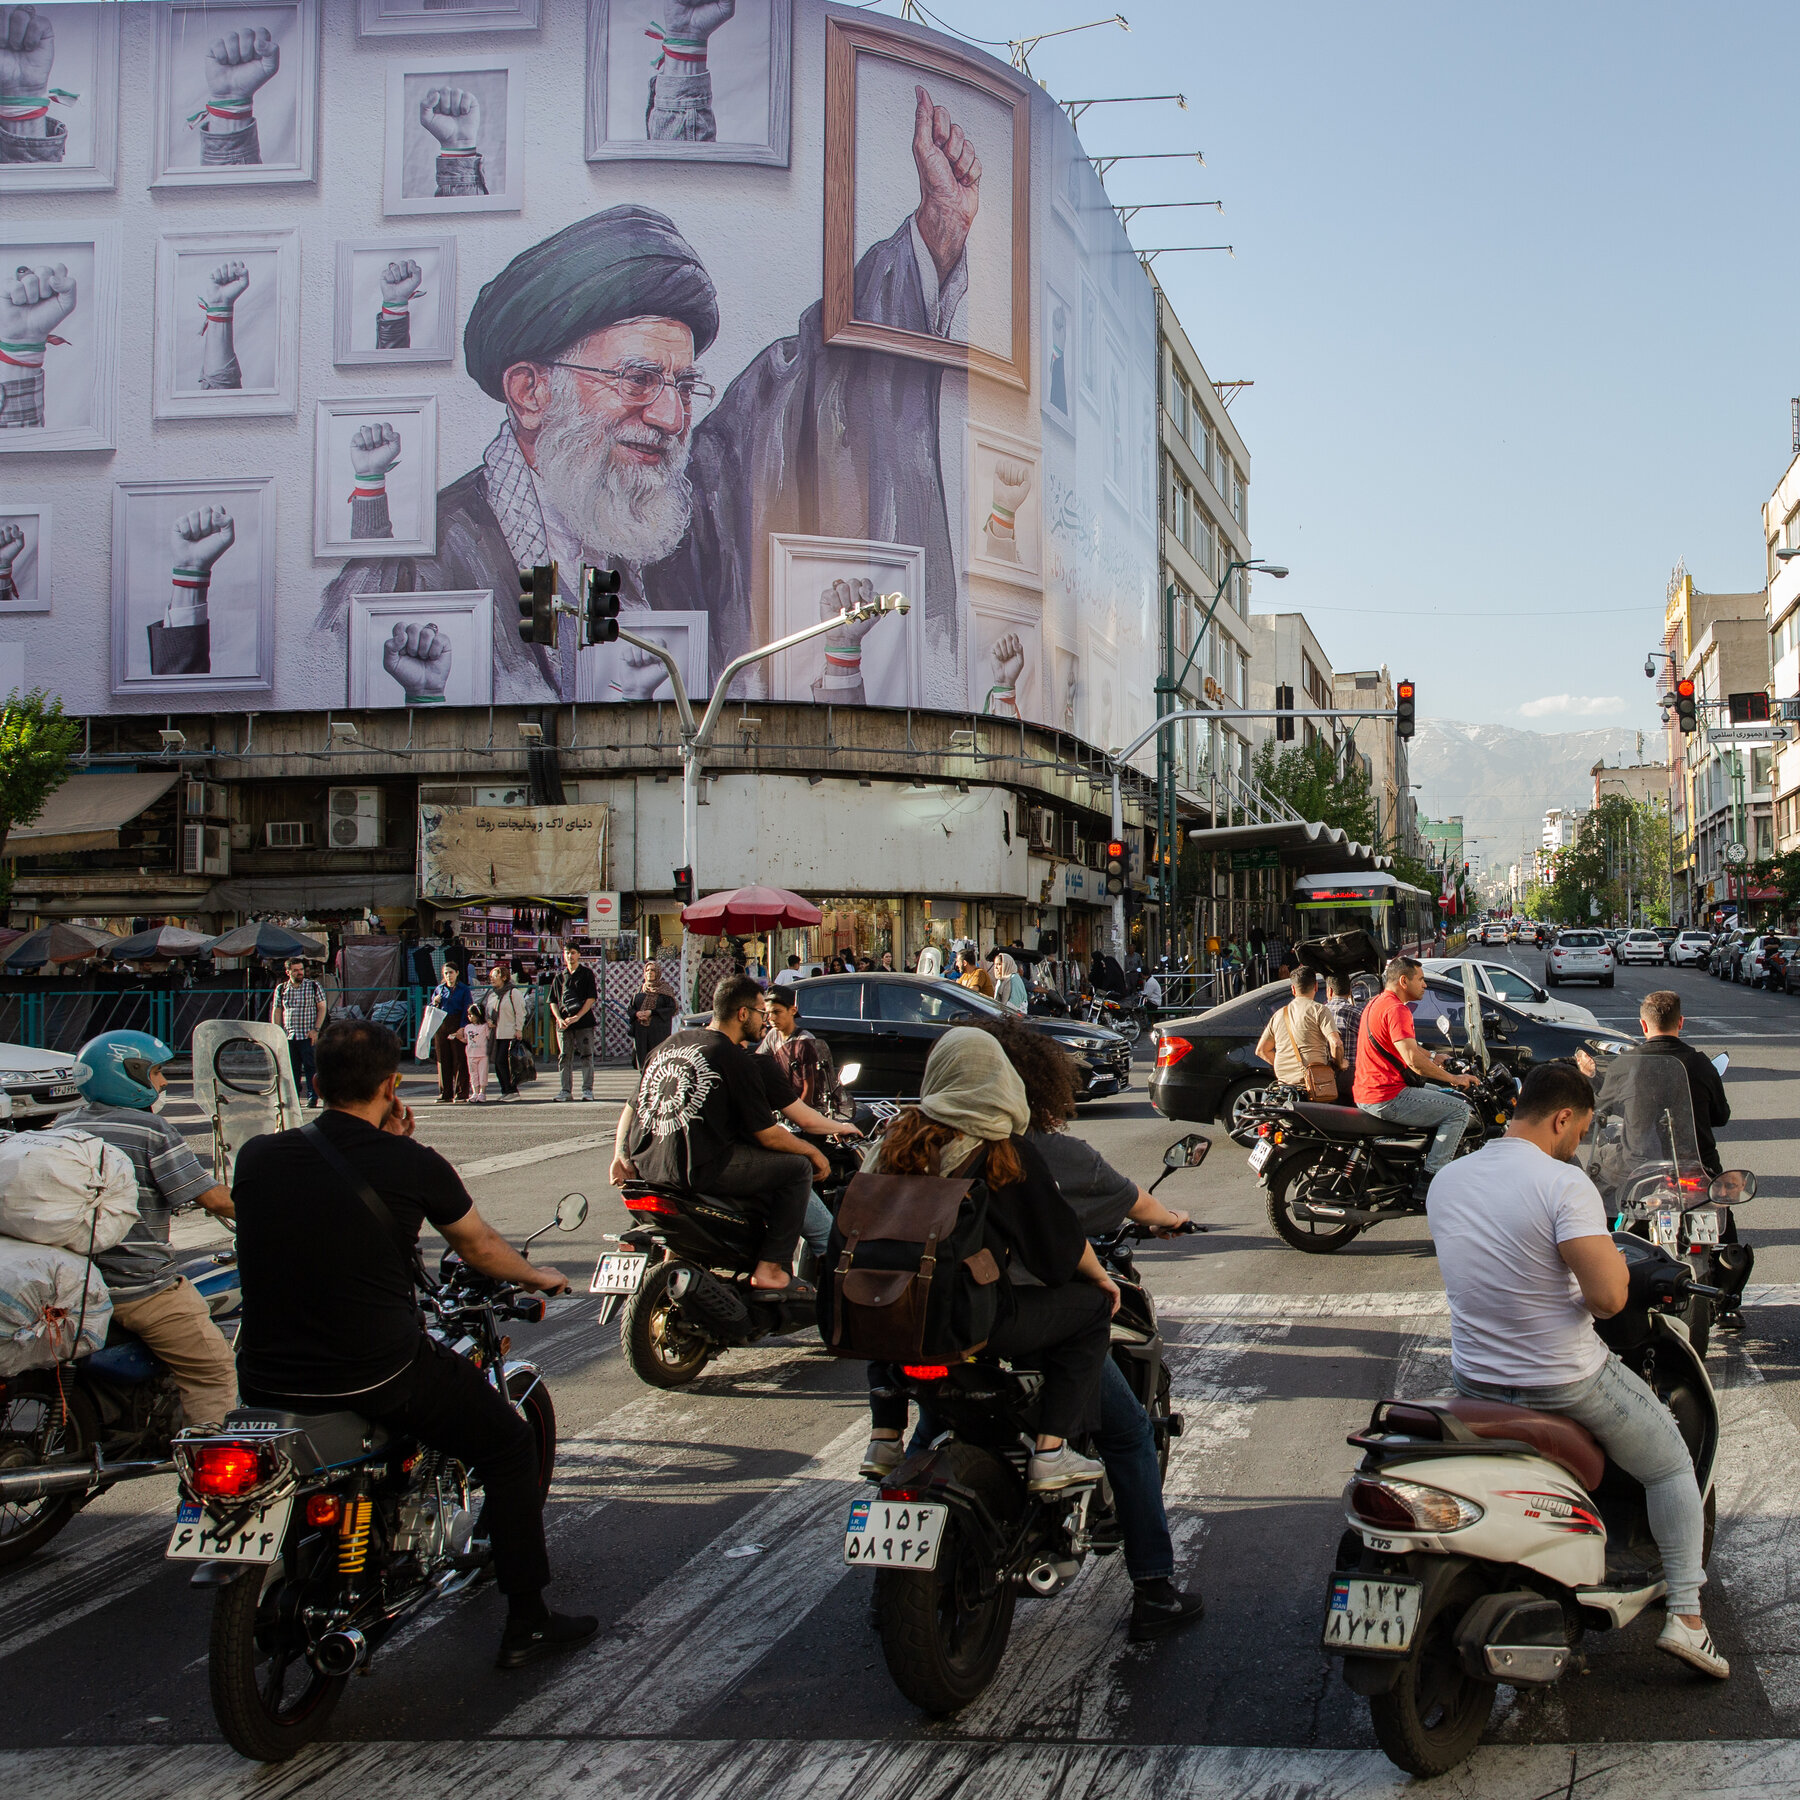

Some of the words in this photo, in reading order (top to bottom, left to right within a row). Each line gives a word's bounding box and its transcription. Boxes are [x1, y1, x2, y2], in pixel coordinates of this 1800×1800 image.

[1711, 731, 1735, 740] اسلامی
[1736, 731, 1762, 739] جمهوری
[476, 817, 495, 832] روشا
[545, 817, 564, 829] لاک
[565, 817, 593, 832] دنیای
[1368, 889, 1375, 897] 7
[617, 1258, 640, 1271] ۱۵۷
[227, 1421, 278, 1430] KAVIR
[885, 1507, 930, 1531] ۱۵۴
[848, 1536, 931, 1562] ۵۸۹۴۶
[1370, 1537, 1393, 1550] TVS
[1363, 1584, 1406, 1612] ۱۳۳
[1332, 1602, 1347, 1610] IRAN
